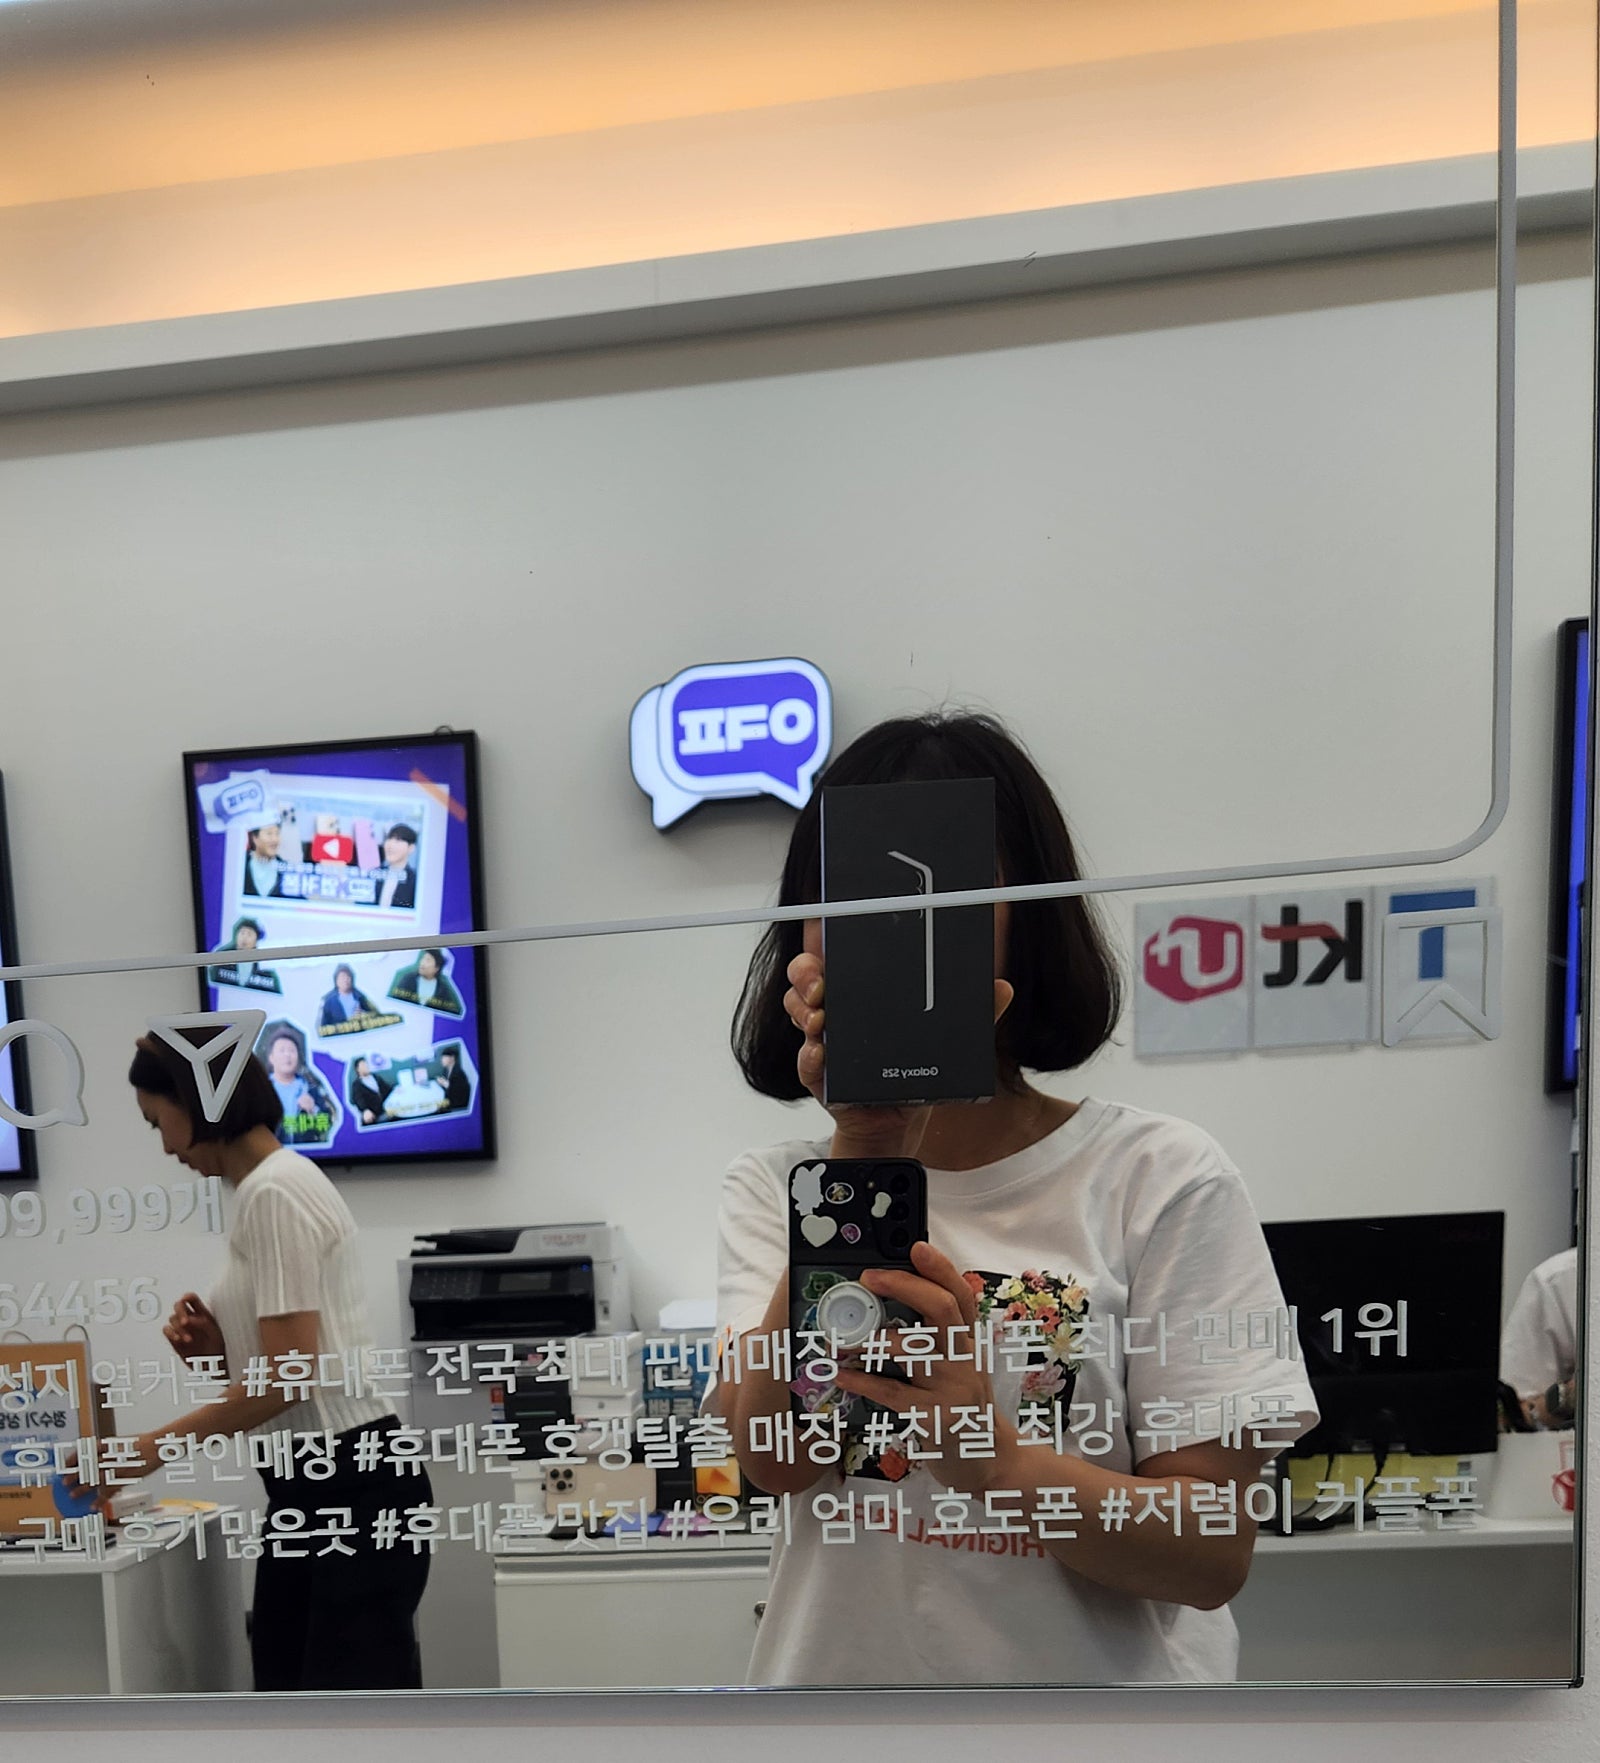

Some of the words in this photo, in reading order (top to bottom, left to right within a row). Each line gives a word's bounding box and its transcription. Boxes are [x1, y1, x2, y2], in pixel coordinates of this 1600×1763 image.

[0, 1359, 79, 1412] 성지
[92, 1355, 231, 1409] 옆커폰
[242, 1349, 413, 1401] #휴대폰
[427, 1343, 521, 1395] 전국
[535, 1336, 629, 1391] 최대
[645, 1327, 845, 1387] 판매매장
[860, 1320, 1051, 1377] #휴대폰
[1069, 1312, 1176, 1368] 최다
[1193, 1305, 1298, 1365] 판매
[1320, 1300, 1408, 1357] 1위
[9, 1436, 146, 1488] 휴대폰
[155, 1428, 342, 1481] 할인매장
[353, 1423, 526, 1476] #휴대폰
[539, 1413, 733, 1471] 호갱탈출
[749, 1409, 848, 1465] 매장
[863, 1403, 996, 1460] #친절
[1016, 1398, 1121, 1455] 최강
[1136, 1395, 1301, 1452] 휴대폰
[16, 1512, 106, 1563] 구매
[118, 1510, 207, 1562] 후기
[221, 1507, 359, 1559] 많은곳
[371, 1501, 539, 1554] #휴대폰
[557, 1497, 648, 1550] 맛집
[667, 1492, 791, 1547] #우리
[812, 1488, 912, 1544] 엄마
[927, 1486, 1083, 1539] 효도폰
[1098, 1477, 1292, 1537] #저렴이
[1314, 1476, 1483, 1533] 커플폰
